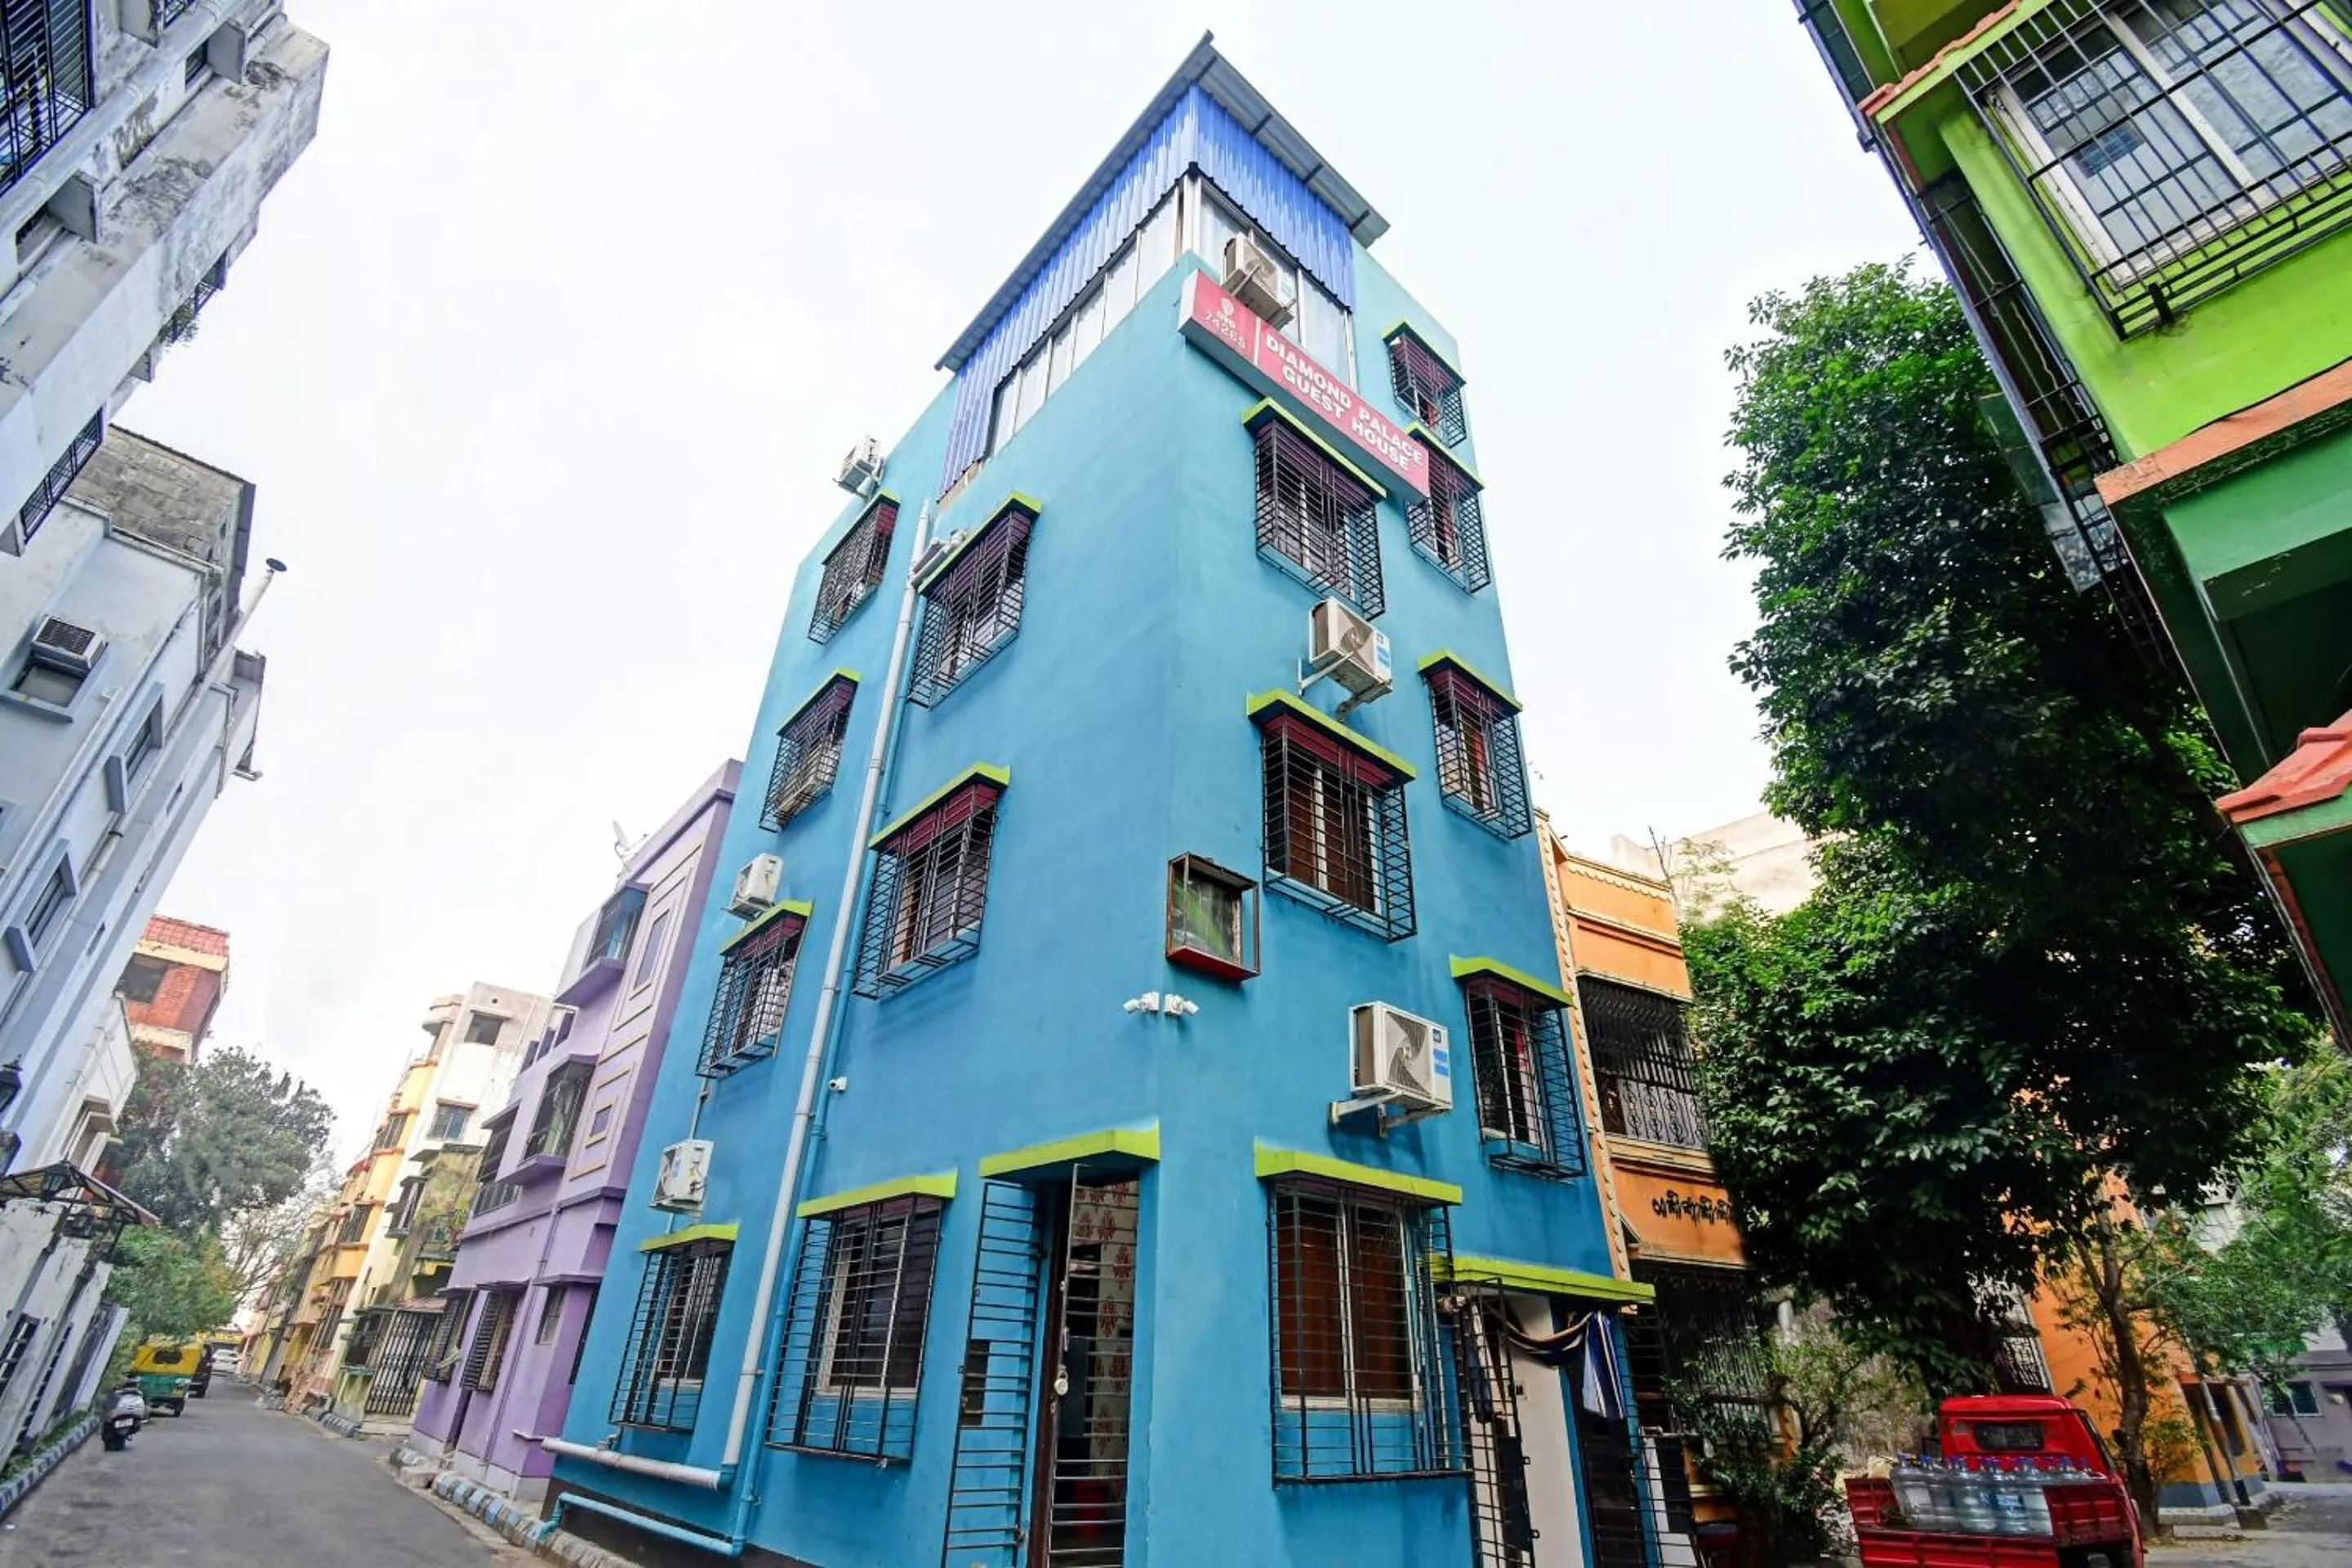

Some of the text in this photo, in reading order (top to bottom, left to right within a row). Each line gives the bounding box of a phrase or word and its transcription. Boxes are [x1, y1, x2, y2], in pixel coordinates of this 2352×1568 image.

[1266, 333, 1423, 464] DIAMOND PALACE
[1281, 366, 1410, 471] GUEST HOUSE
